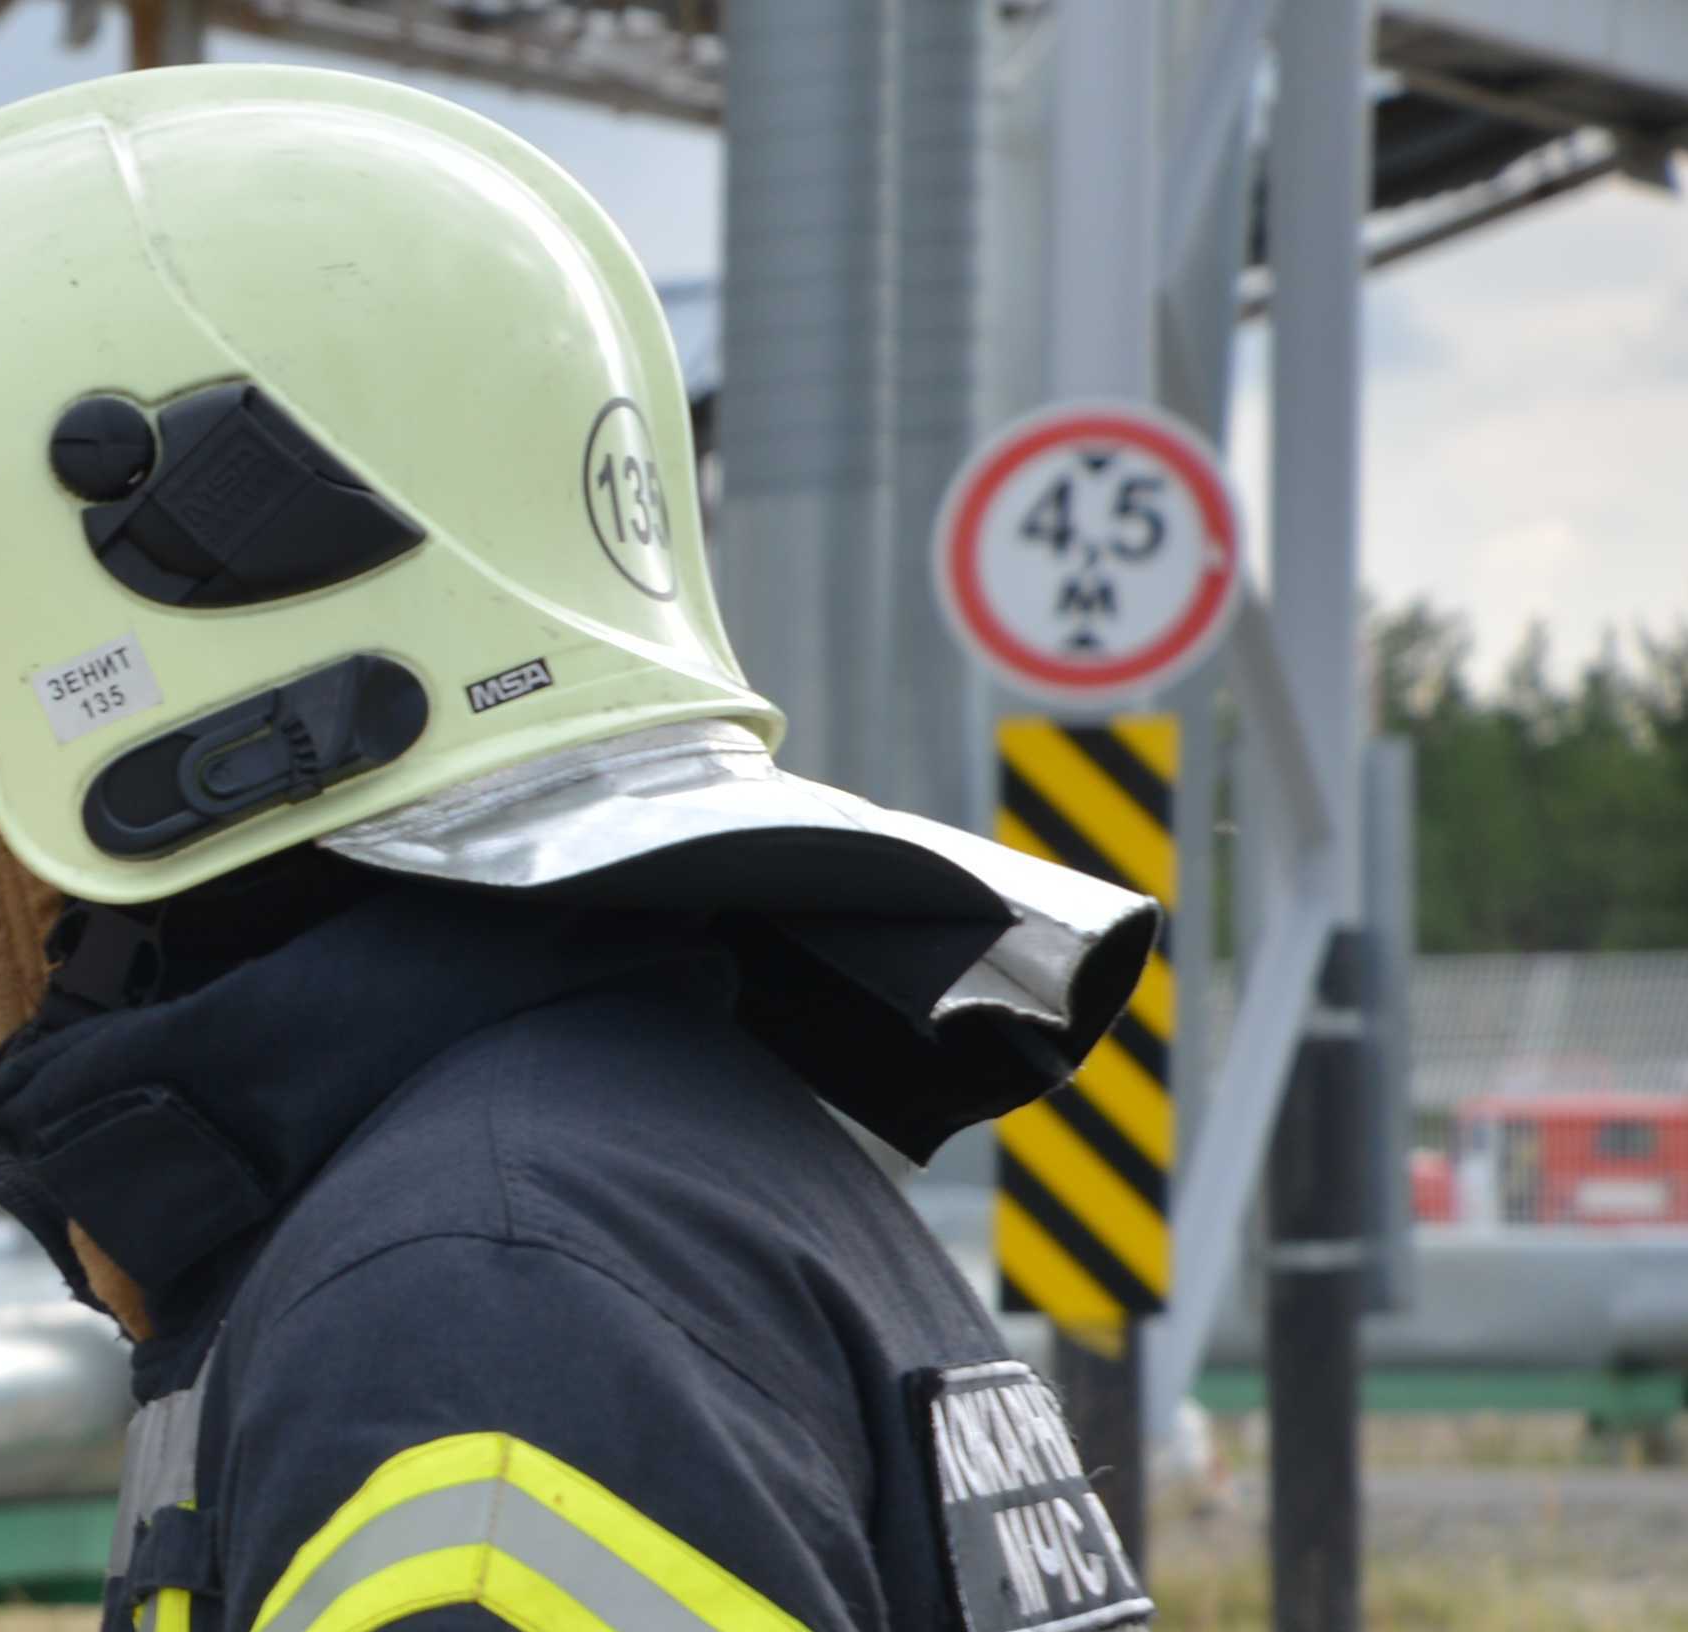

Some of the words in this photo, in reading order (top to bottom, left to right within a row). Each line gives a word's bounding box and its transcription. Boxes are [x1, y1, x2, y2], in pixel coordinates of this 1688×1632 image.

[46, 645, 132, 702] ЗЕНИТ
[469, 661, 551, 711] MSA
[79, 684, 126, 720] 135
